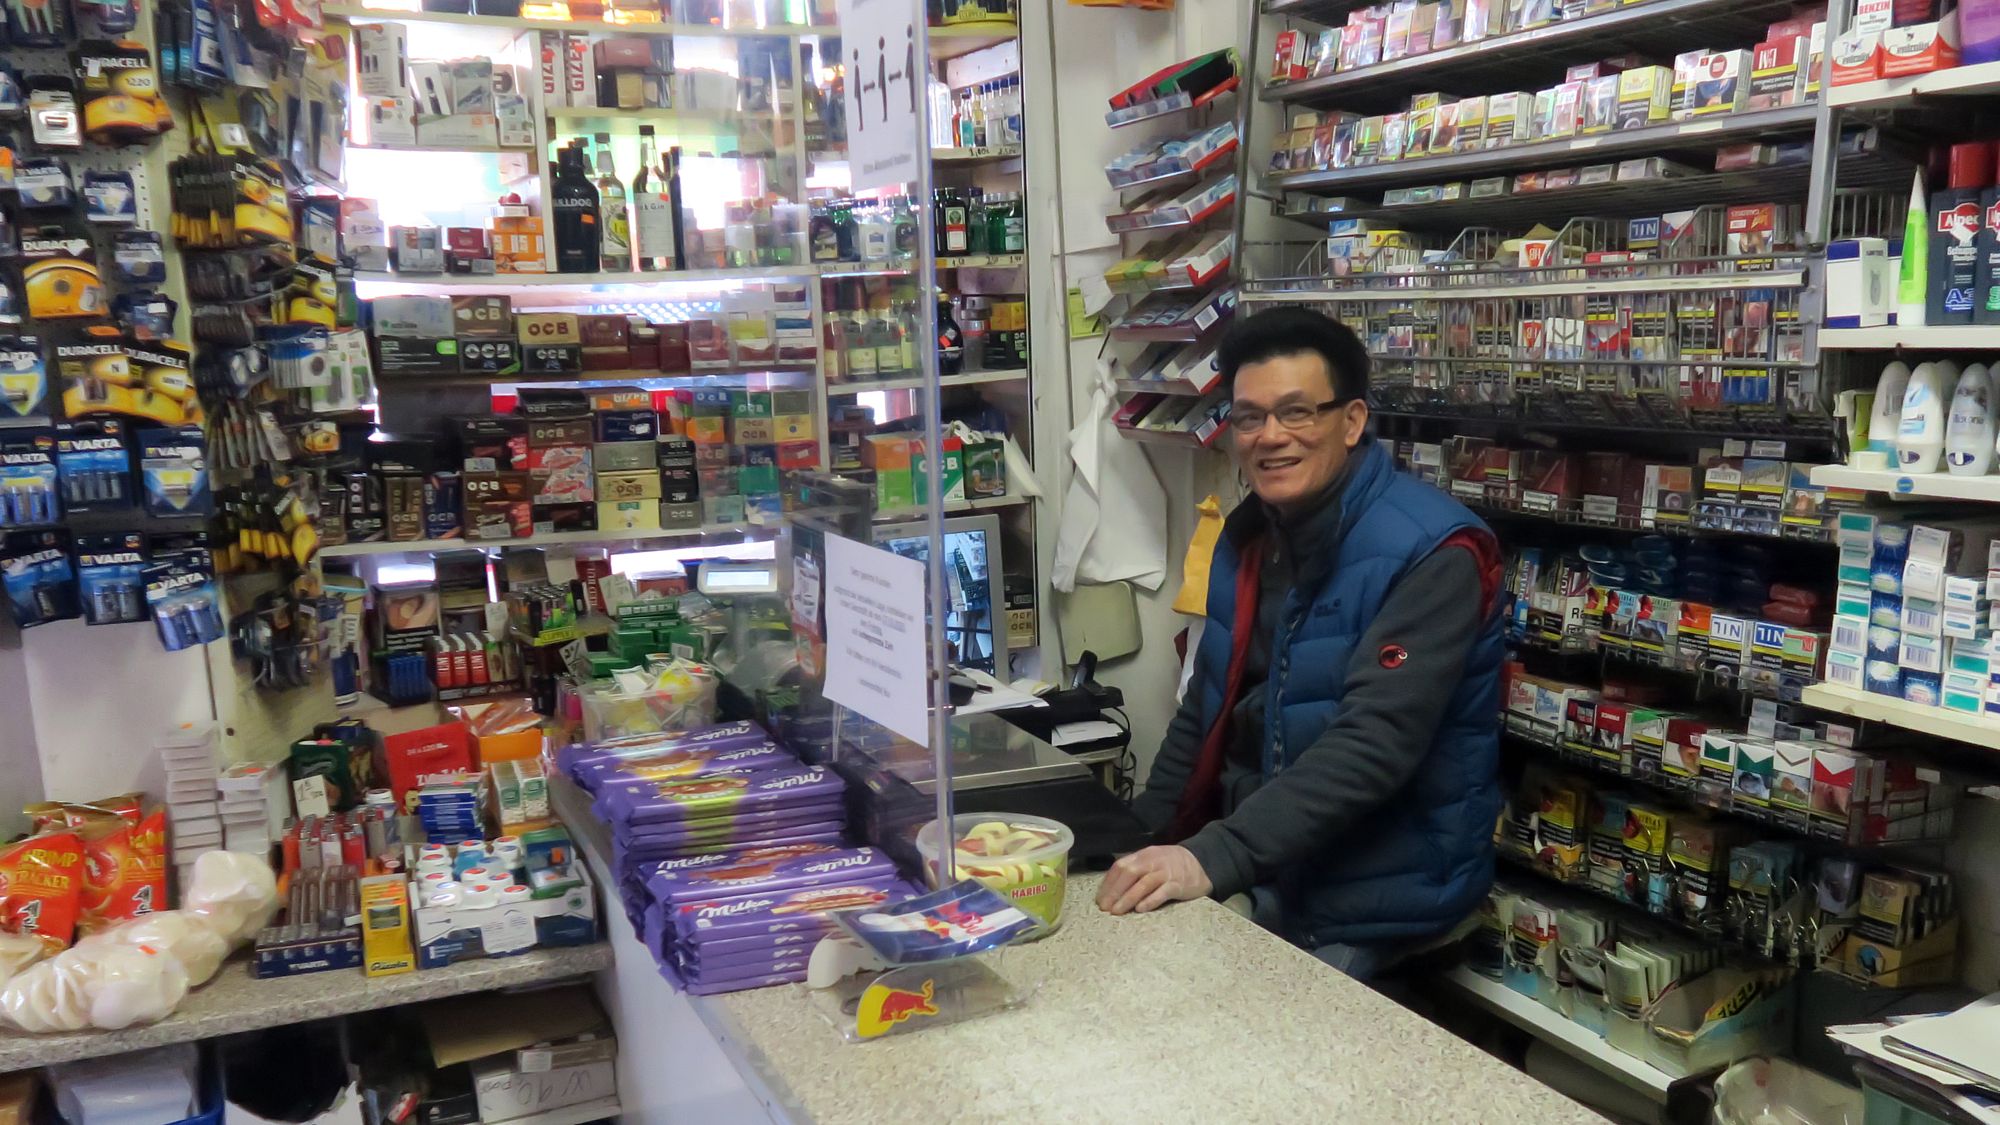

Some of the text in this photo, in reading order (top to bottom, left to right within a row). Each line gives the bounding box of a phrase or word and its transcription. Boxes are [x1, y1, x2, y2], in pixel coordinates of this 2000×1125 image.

[528, 321, 569, 336] OCB
[58, 345, 122, 357] DURACELL
[71, 438, 121, 451] VARTA
[4, 453, 48, 464] VARTA
[467, 480, 500, 491] OCB
[94, 553, 142, 565] VARTA
[157, 571, 205, 591] VARTA
[691, 721, 750, 741] Milka
[714, 746, 776, 761] Milka
[759, 771, 824, 790] Milka
[657, 853, 729, 870] Milka
[802, 854, 872, 874] Milka
[1011, 884, 1048, 900] HARIBO
[697, 898, 774, 919] Milka
